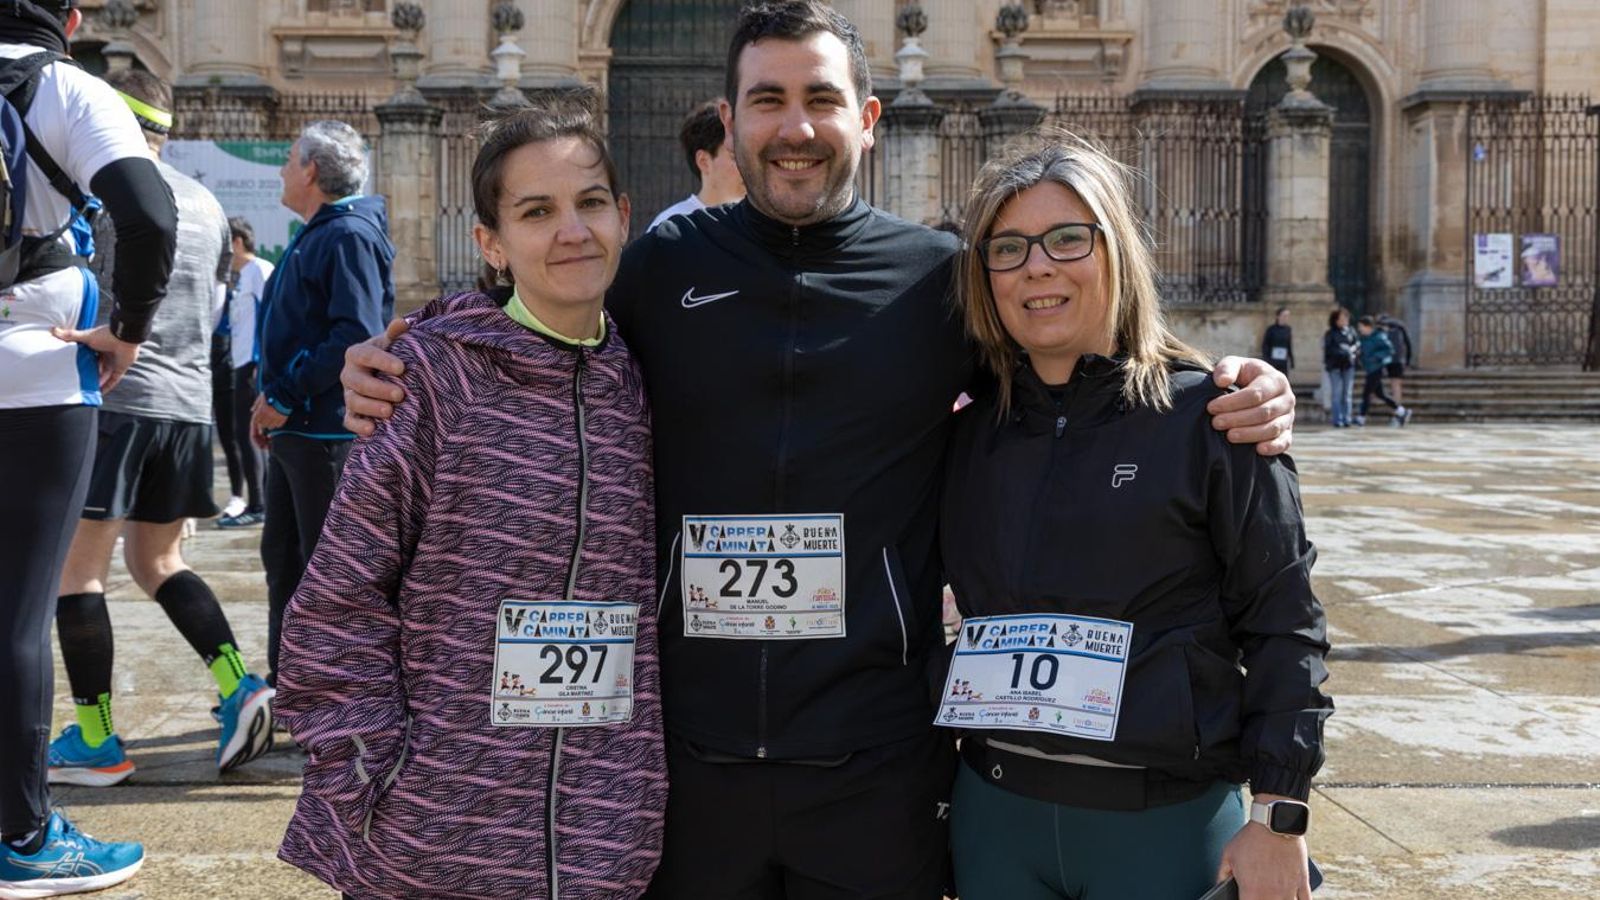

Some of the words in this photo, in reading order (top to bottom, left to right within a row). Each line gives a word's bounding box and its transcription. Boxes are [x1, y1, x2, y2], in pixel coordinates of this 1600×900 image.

[689, 524, 706, 551] V
[803, 526, 838, 538] BUENA
[706, 540, 775, 552] CAMINATA
[803, 539, 838, 550] MUERTE
[719, 559, 798, 598] 273
[524, 624, 590, 637] CAMINATA
[967, 625, 987, 648] V
[1087, 629, 1123, 643] BUENA
[982, 635, 1055, 649] CAMINATA
[1085, 642, 1121, 655] MUERTE
[540, 645, 607, 684] 297
[1010, 653, 1059, 690] 10
